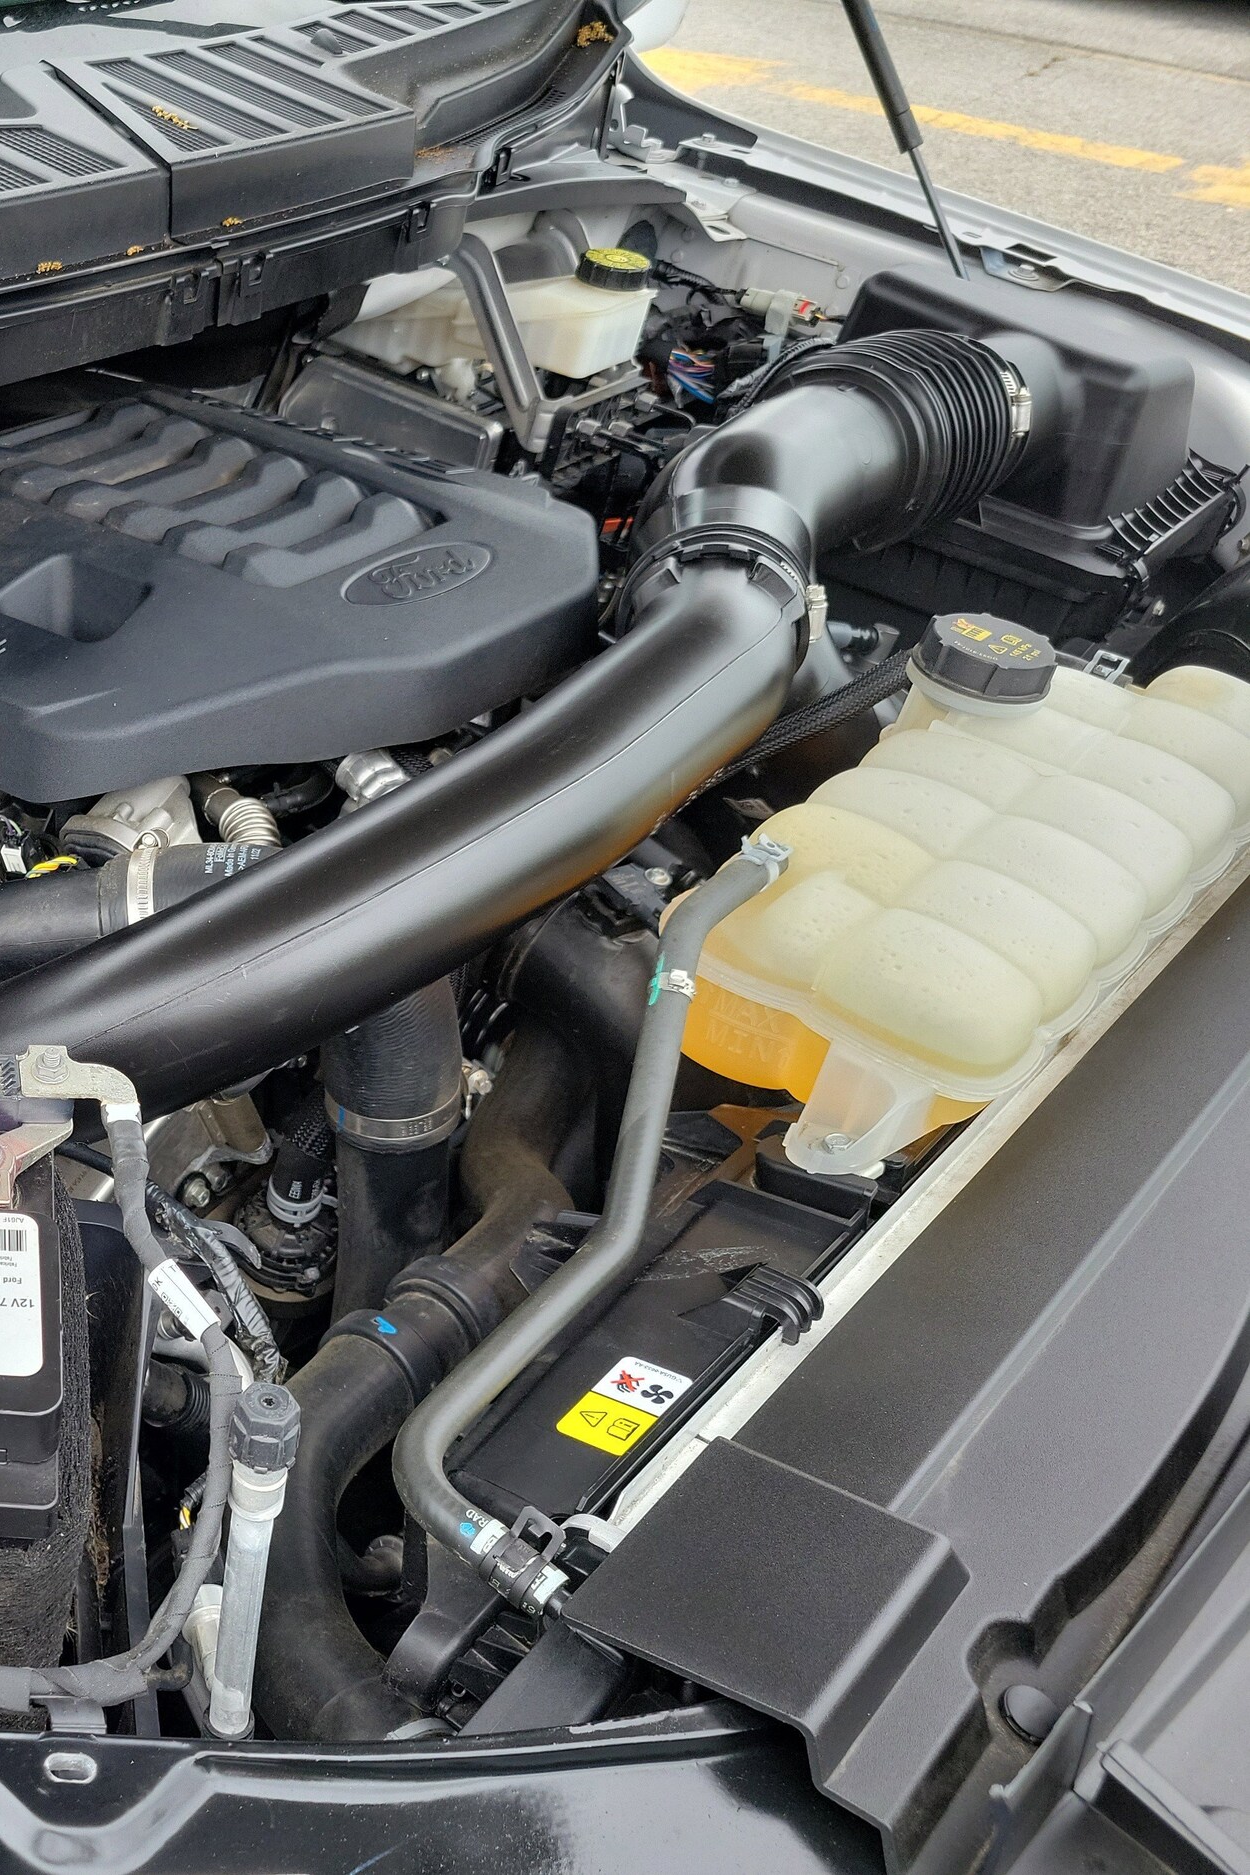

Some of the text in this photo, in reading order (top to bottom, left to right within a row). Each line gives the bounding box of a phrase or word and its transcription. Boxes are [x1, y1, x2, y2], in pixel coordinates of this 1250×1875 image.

[367, 550, 475, 599] Ford
[3, 1275, 22, 1284] Ford
[11, 1298, 35, 1308] 12V
[465, 1509, 489, 1528] RAD
